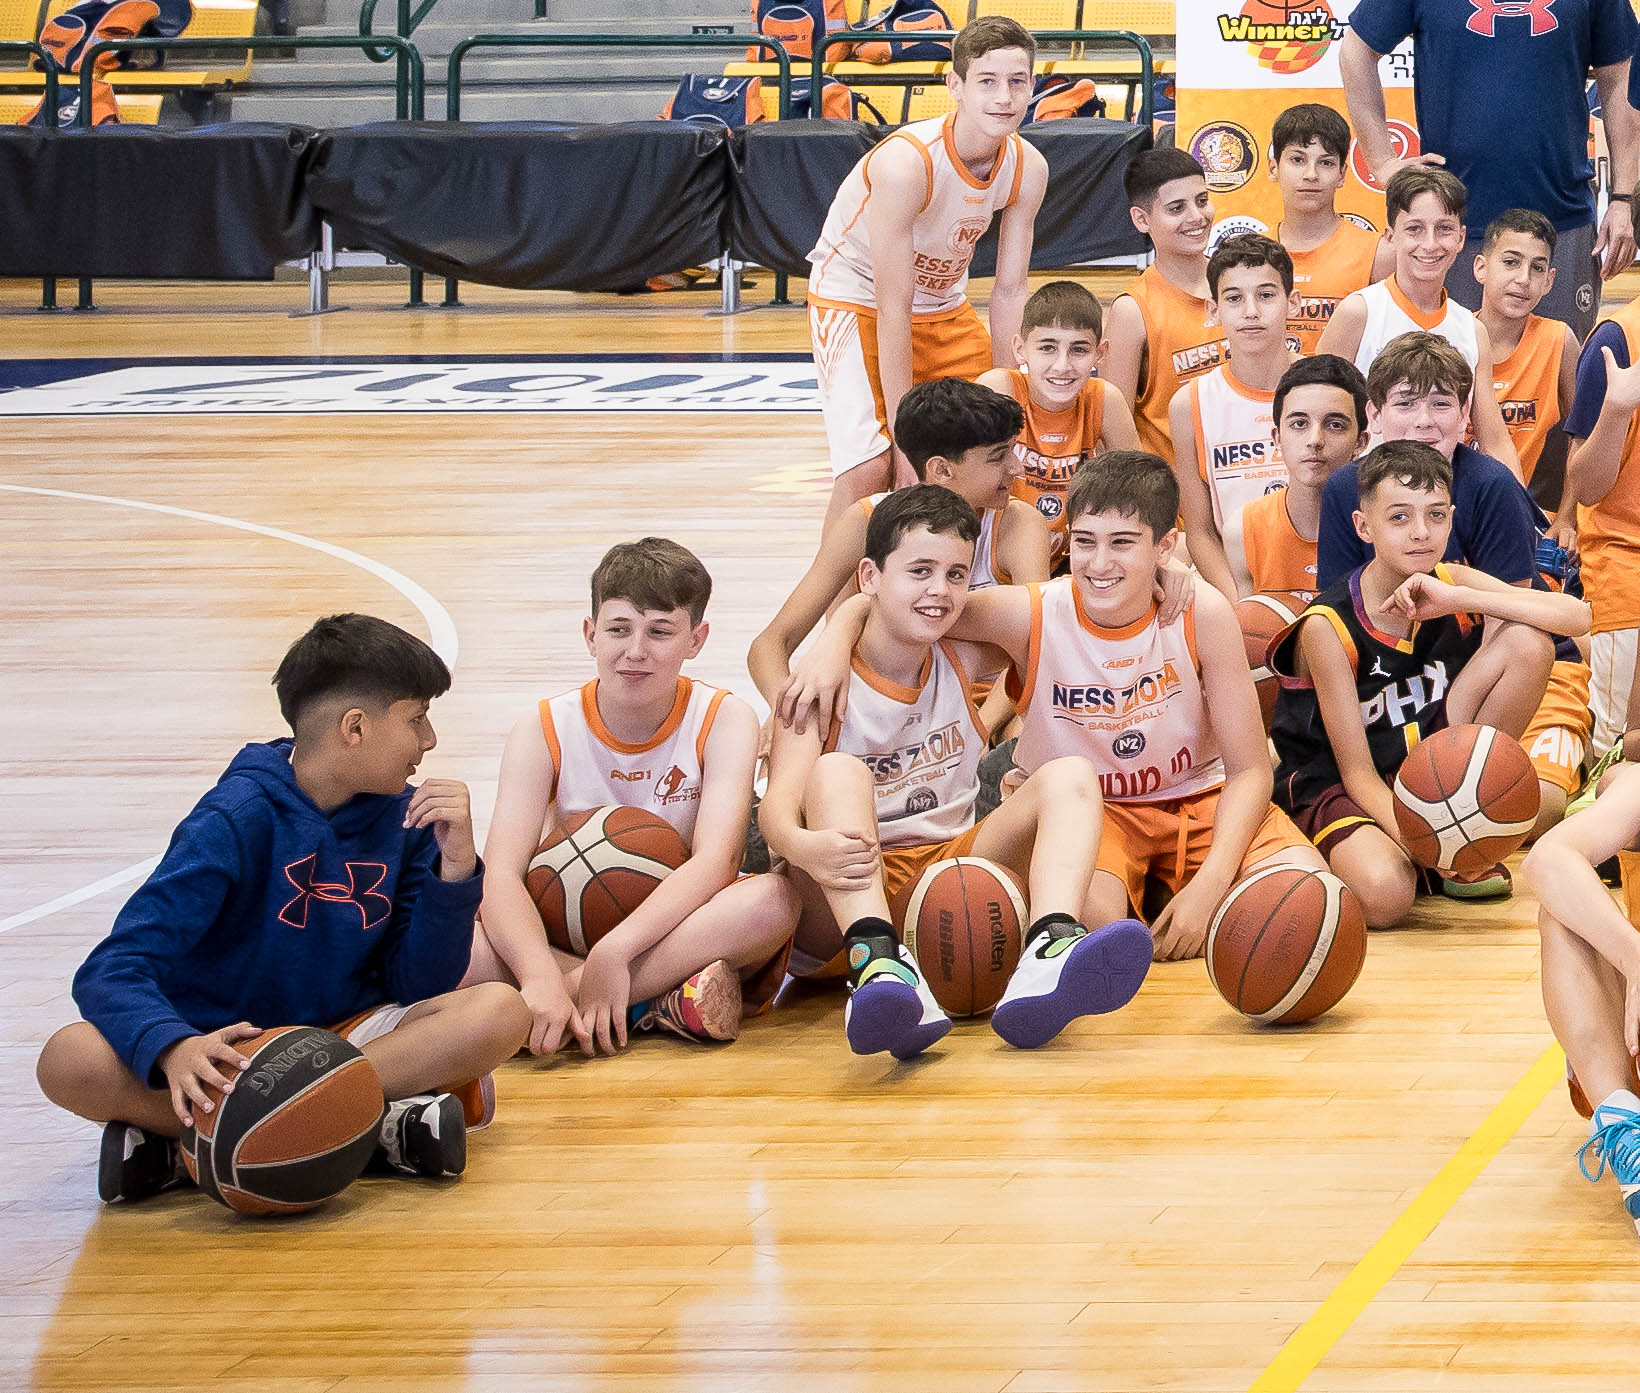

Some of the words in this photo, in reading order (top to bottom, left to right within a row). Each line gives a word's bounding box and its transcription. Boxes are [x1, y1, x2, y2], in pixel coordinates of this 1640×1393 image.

[1288, 7, 1329, 26] ליגת
[914, 252, 953, 273] ESS
[127, 366, 821, 396] Zion
[1213, 442, 1265, 469] NESS
[1041, 499, 1058, 514] NZ
[1053, 682, 1115, 714] NESS
[1119, 736, 1139, 752] NZ
